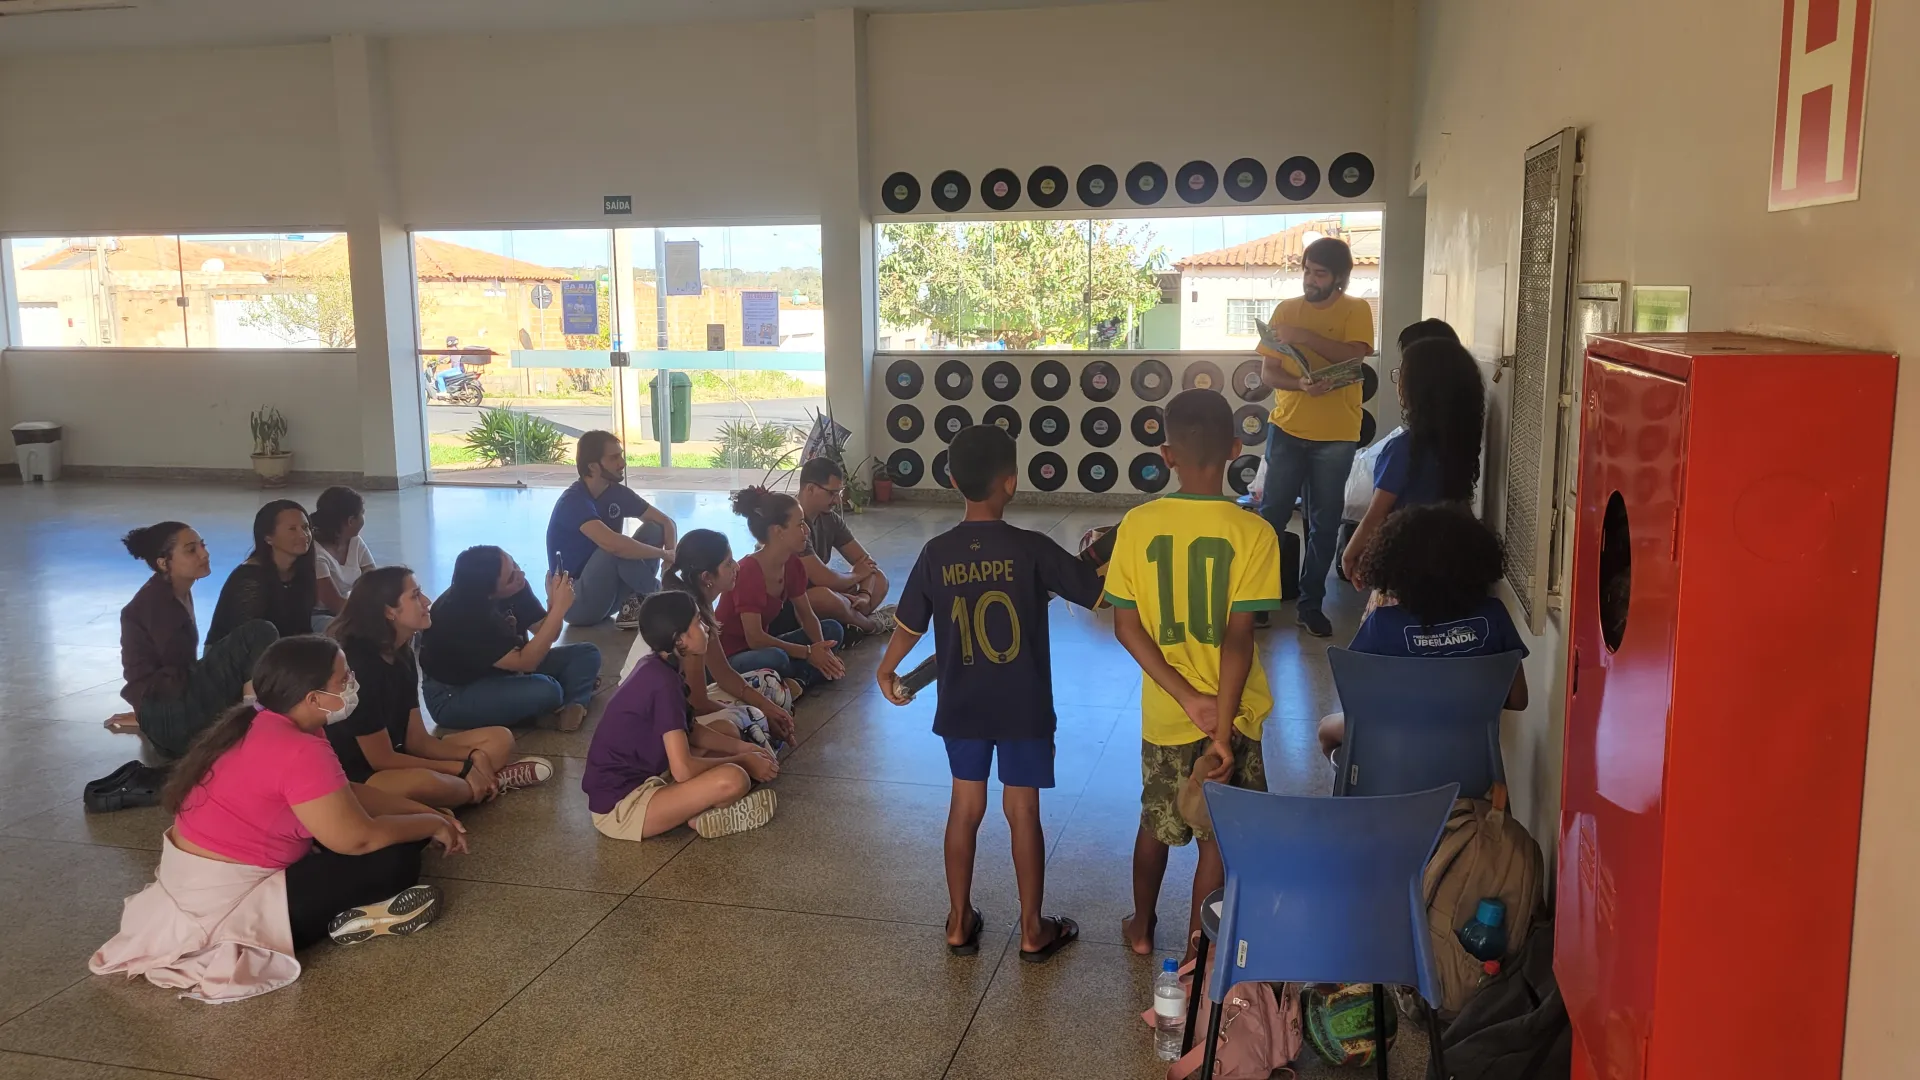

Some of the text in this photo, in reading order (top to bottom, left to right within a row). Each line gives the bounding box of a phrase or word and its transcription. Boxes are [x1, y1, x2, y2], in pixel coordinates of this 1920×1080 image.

[1781, 0, 1857, 190] H
[605, 199, 631, 210] SAÍDA
[942, 560, 1014, 586] MBAPPE
[1146, 534, 1235, 648] 10
[951, 591, 1020, 665] 10
